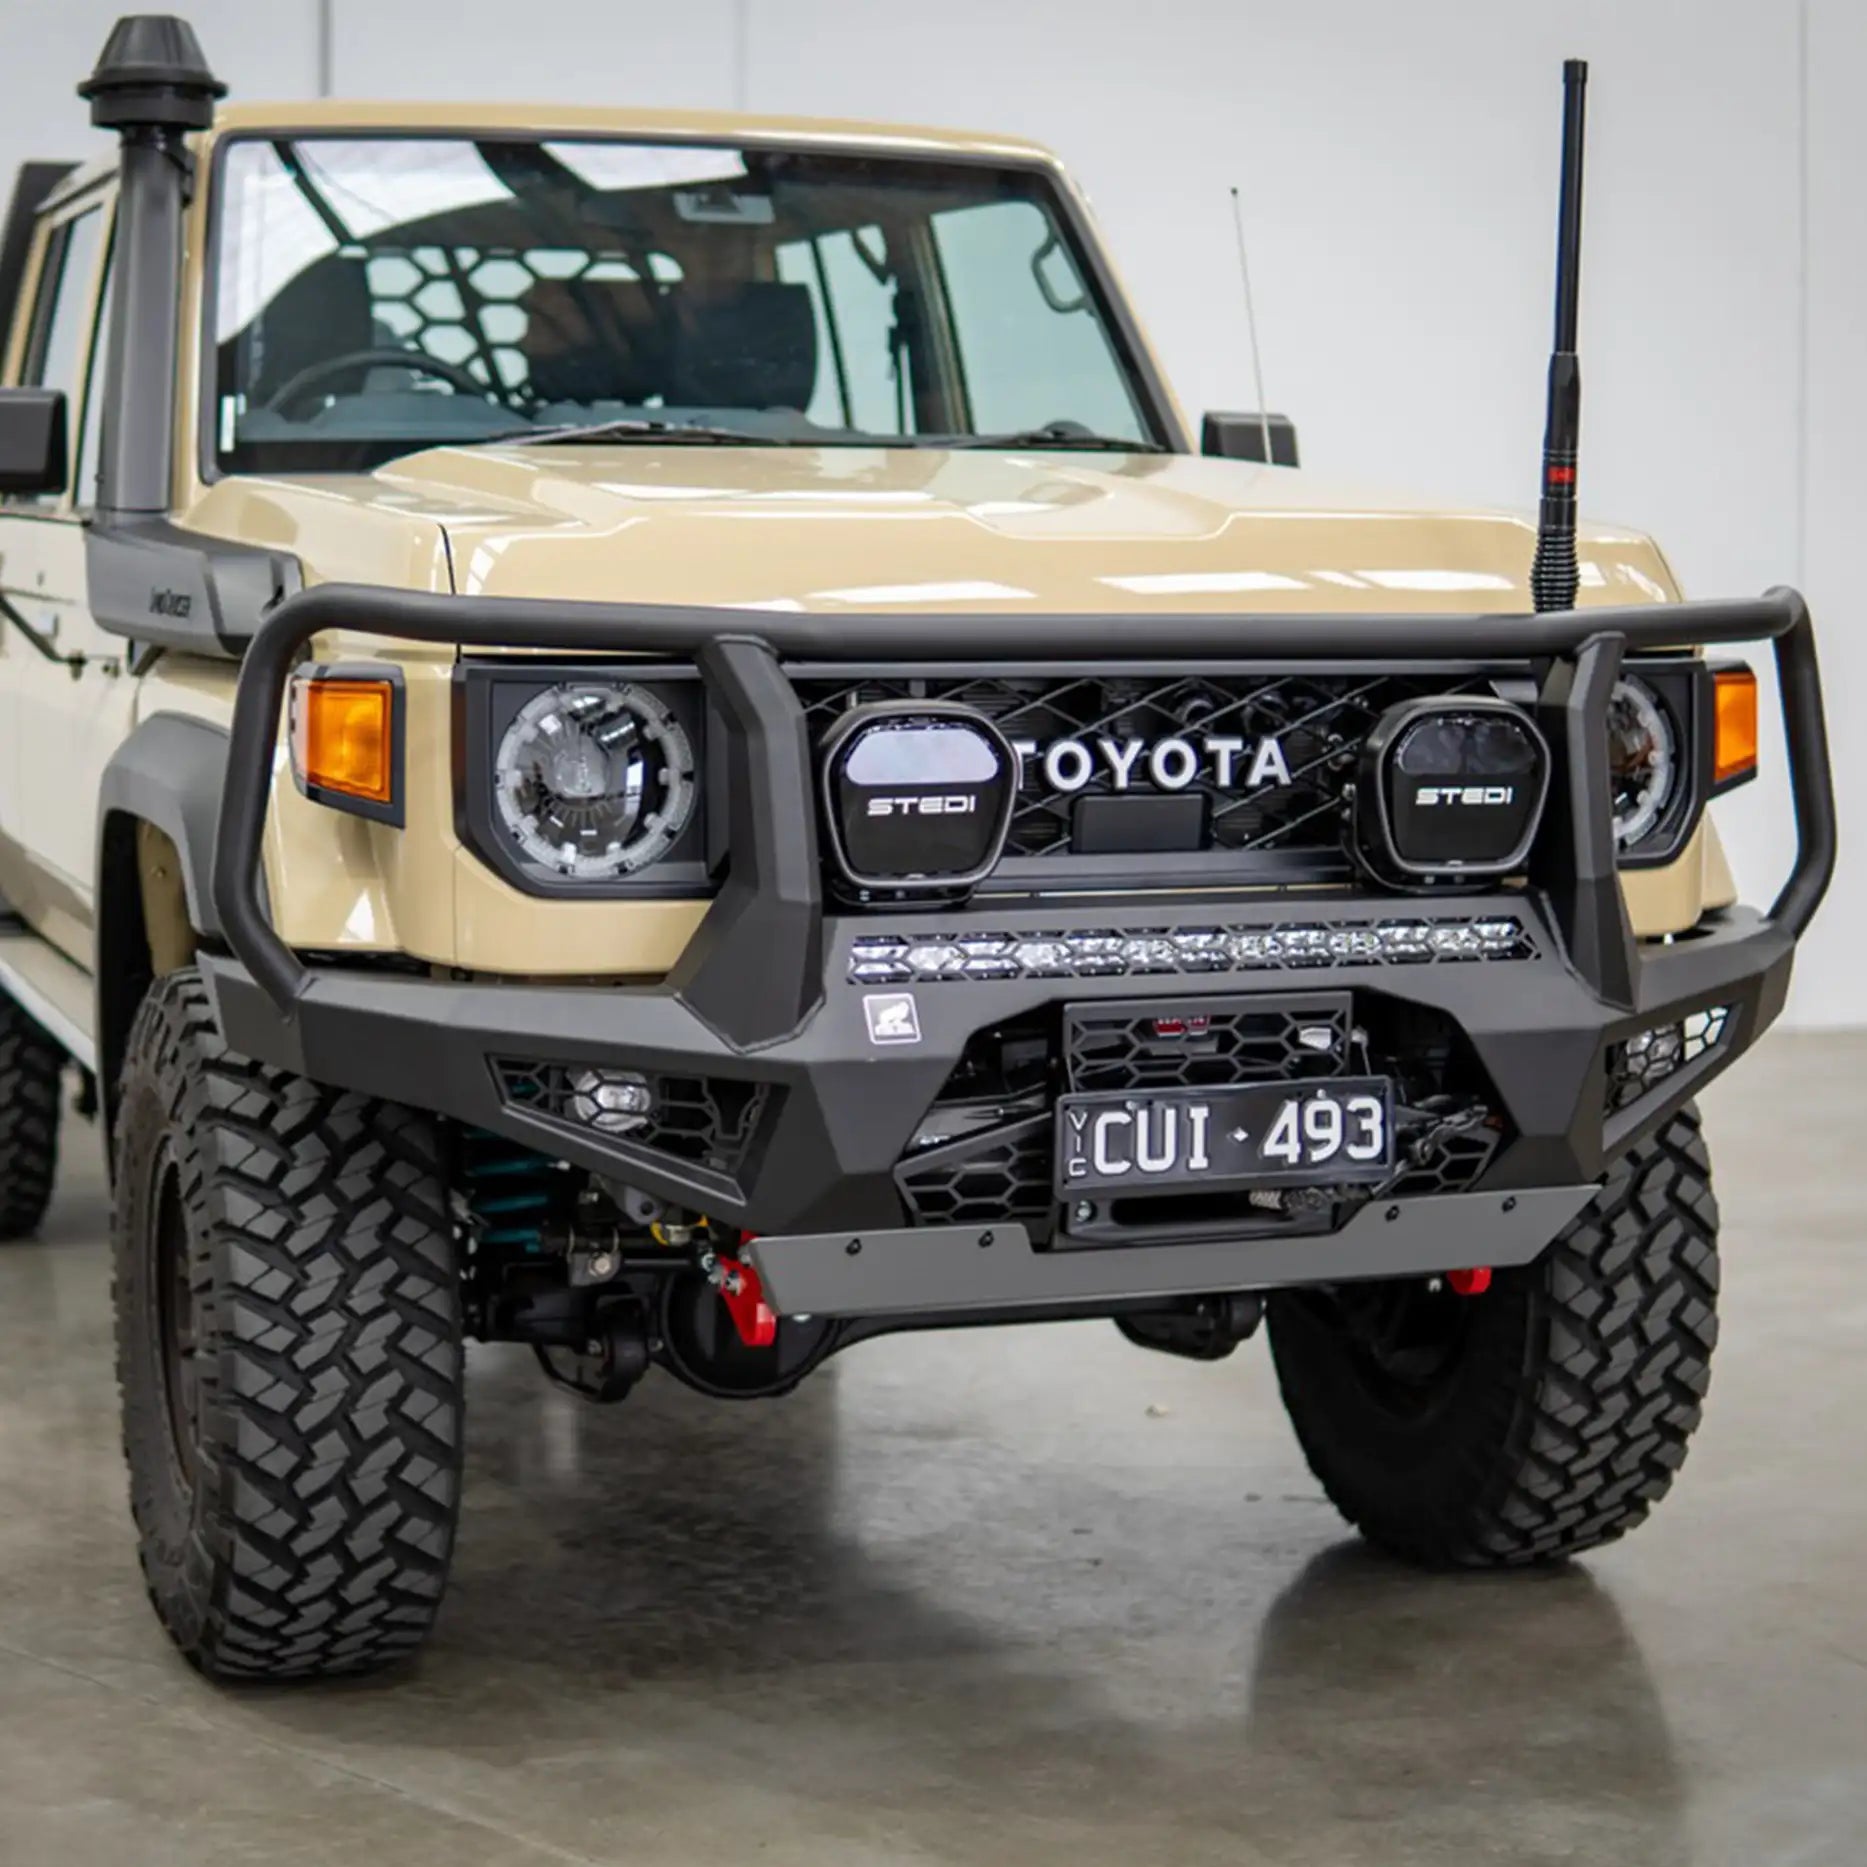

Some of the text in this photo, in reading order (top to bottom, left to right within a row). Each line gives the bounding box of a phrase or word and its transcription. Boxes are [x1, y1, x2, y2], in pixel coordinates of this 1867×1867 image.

[1013, 737, 1292, 791] TOYOTA
[867, 795, 976, 816] STEDI
[1415, 786, 1513, 805] STEDI
[1068, 1110, 1087, 1177] VIC
[1094, 1096, 1384, 1174] CUI 493
